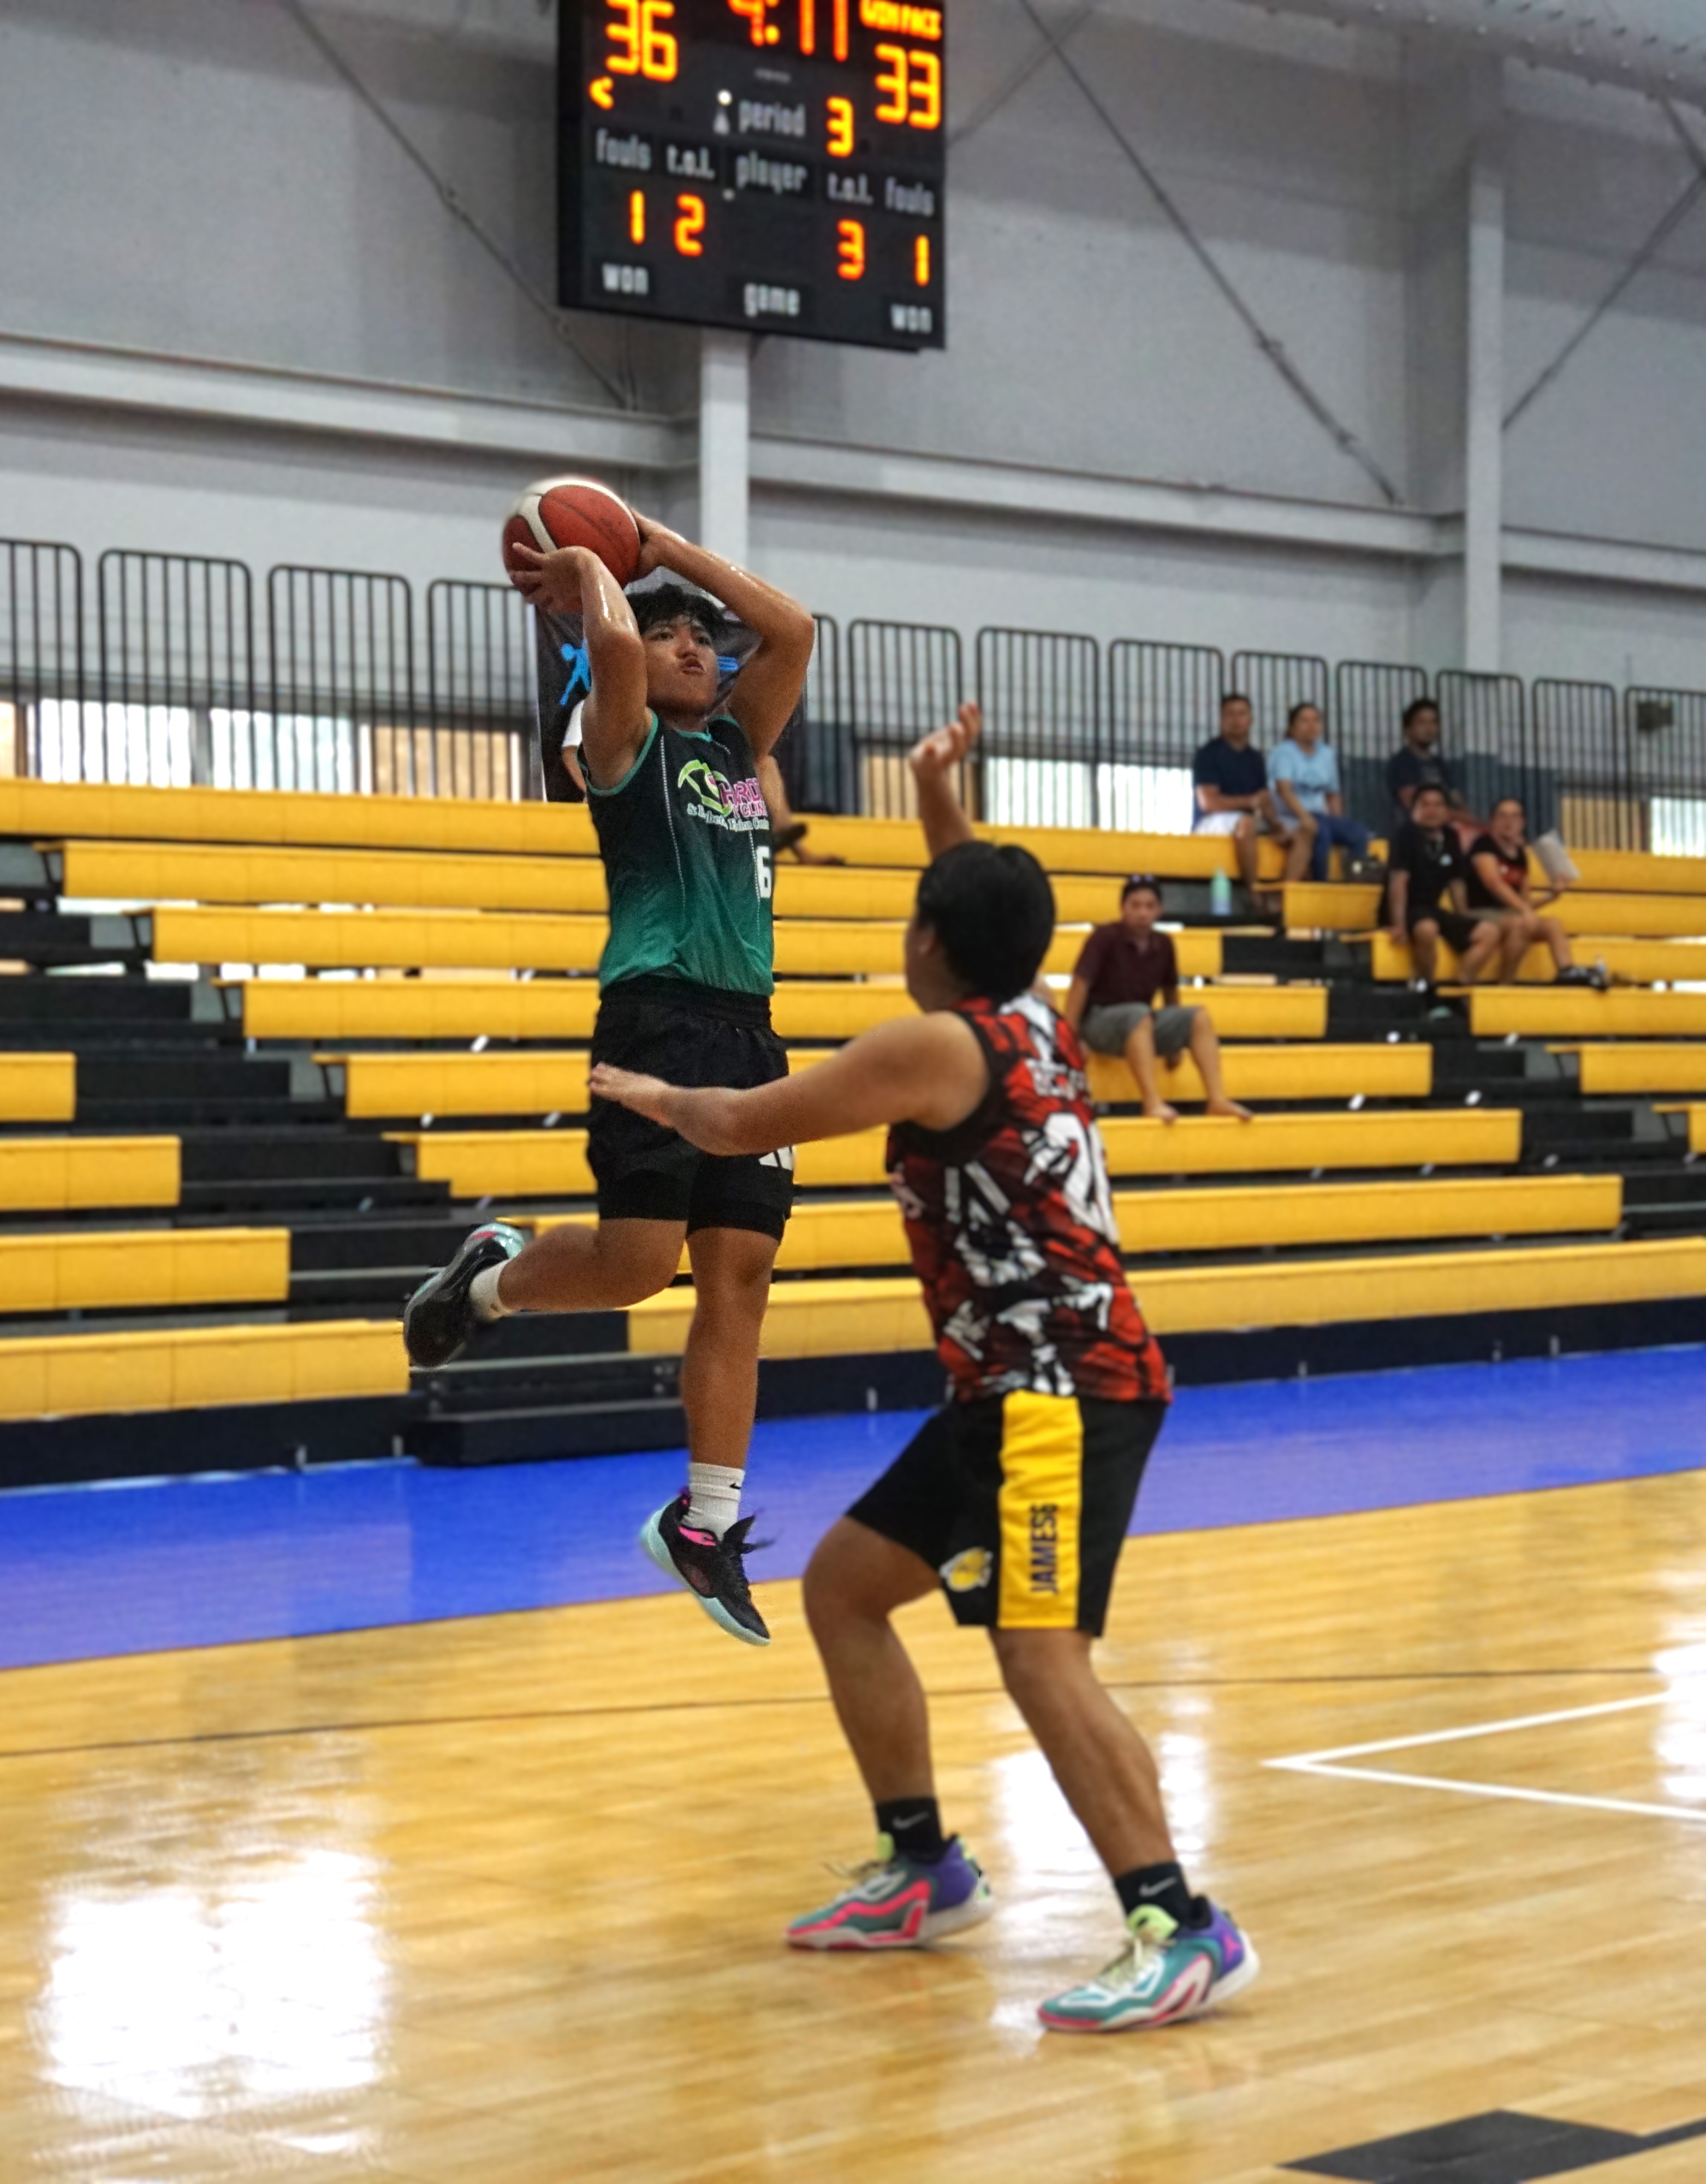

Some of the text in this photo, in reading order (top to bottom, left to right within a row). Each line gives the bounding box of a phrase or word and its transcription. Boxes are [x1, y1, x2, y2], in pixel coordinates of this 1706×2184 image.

[606, 0, 677, 81] 36
[875, 43, 941, 130] 33
[739, 101, 805, 137] period
[827, 97, 853, 157] 3
[596, 129, 651, 170] fouls
[736, 151, 807, 193] player
[631, 191, 644, 244] 1
[885, 176, 934, 216] fouls
[674, 194, 705, 256] 2
[838, 219, 864, 280] 3
[602, 264, 648, 294] won
[916, 236, 929, 285] 1
[744, 283, 800, 317] game
[891, 304, 932, 333] won
[756, 846, 771, 898] 6
